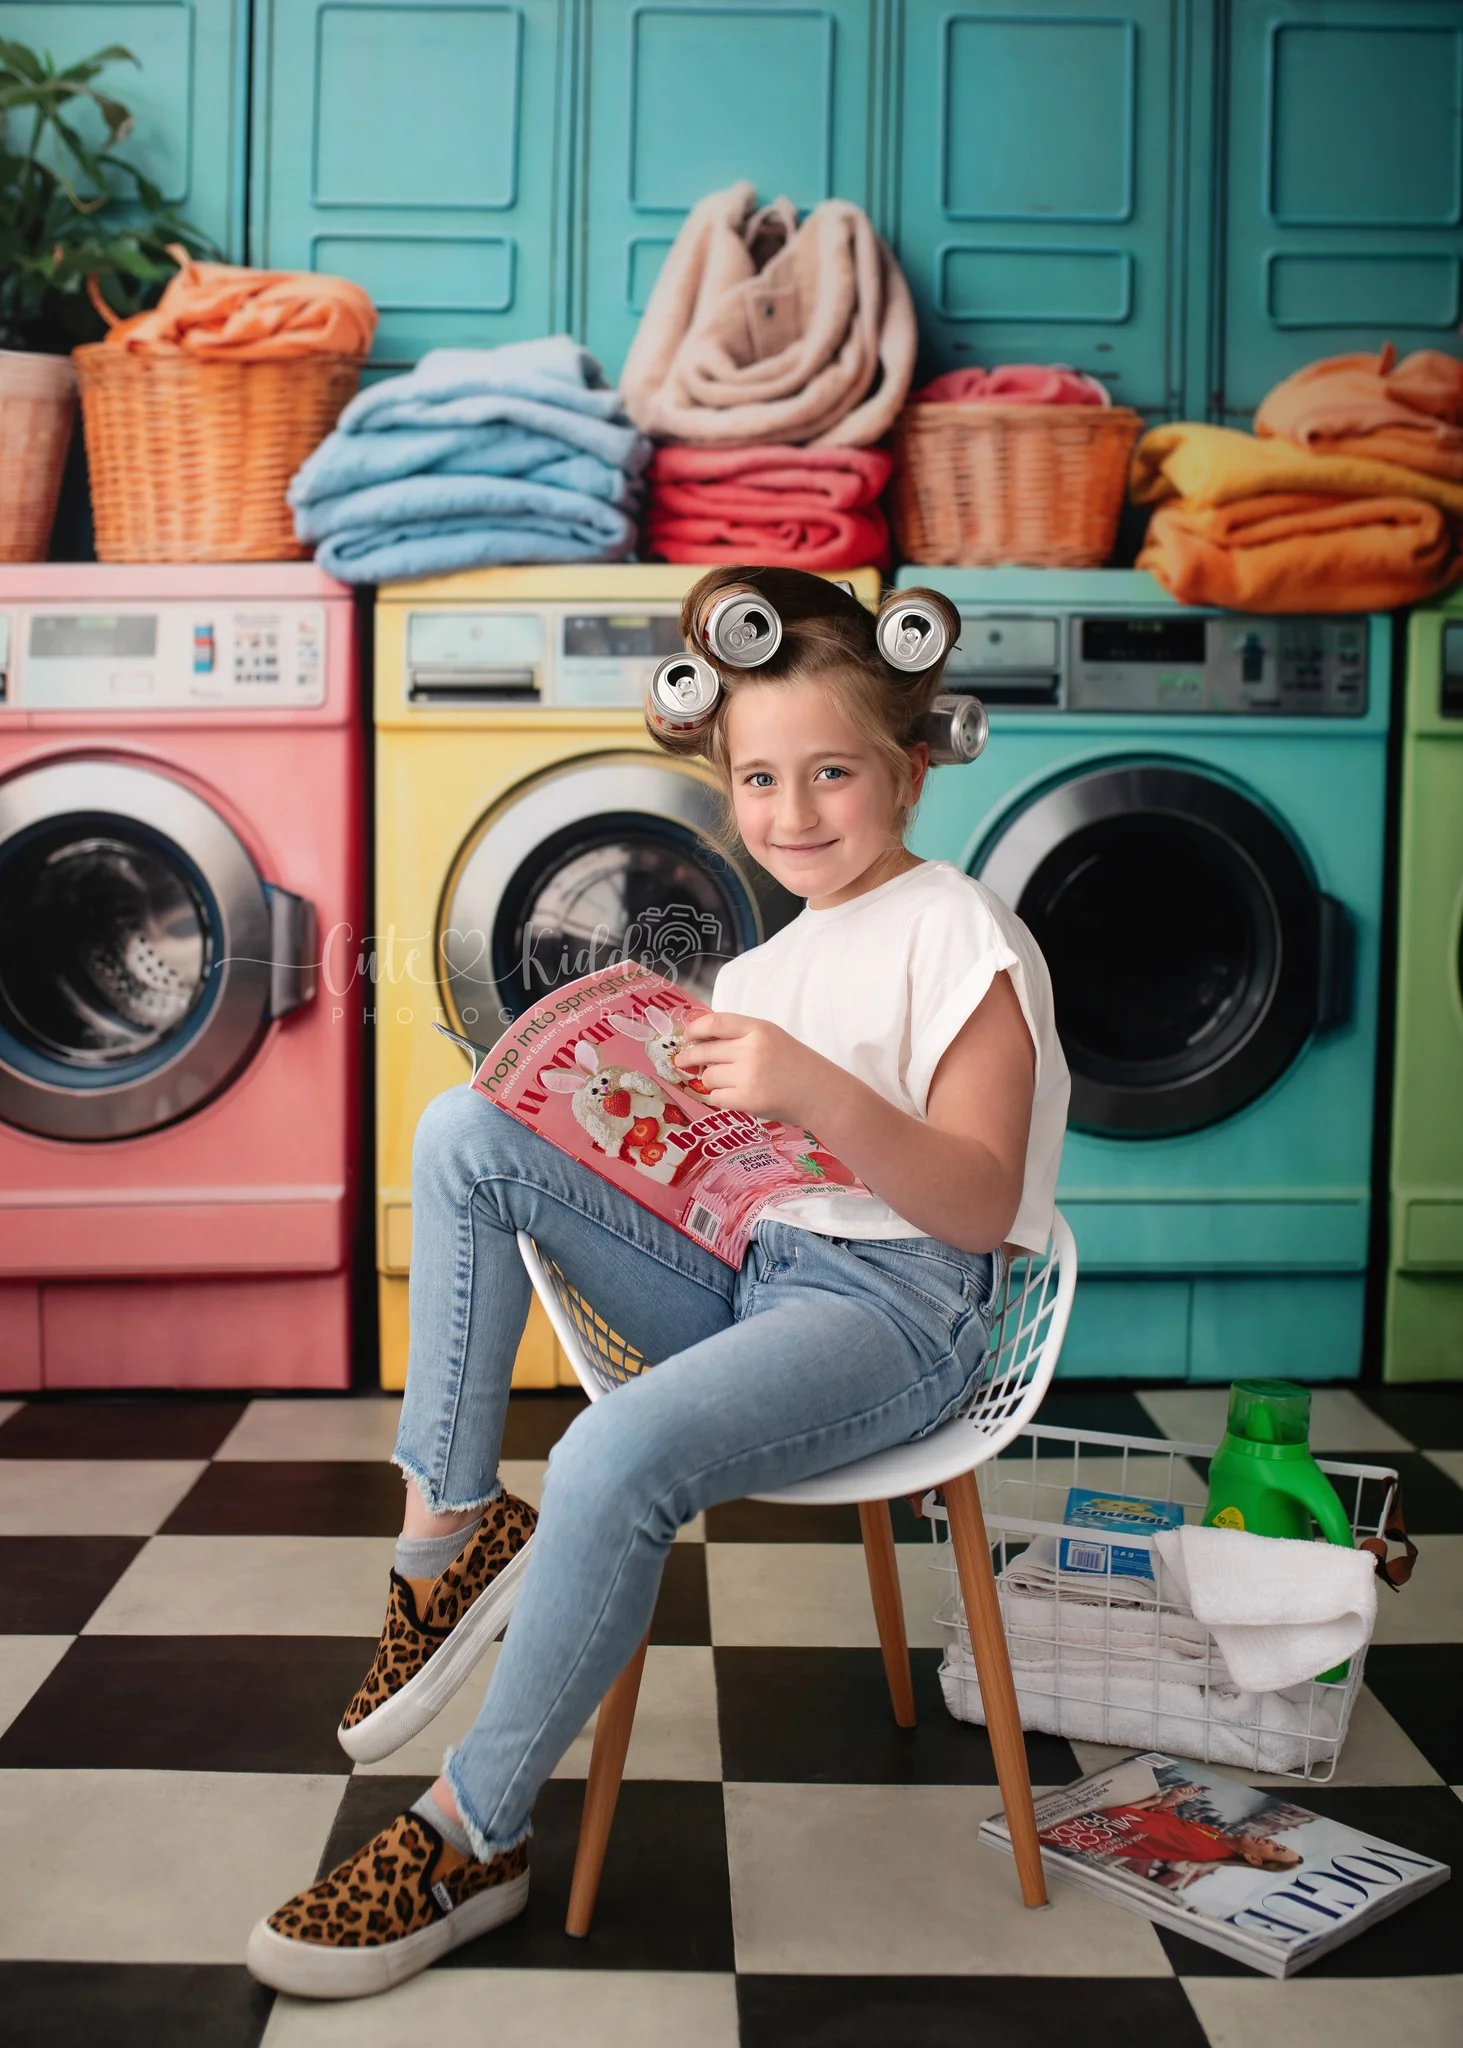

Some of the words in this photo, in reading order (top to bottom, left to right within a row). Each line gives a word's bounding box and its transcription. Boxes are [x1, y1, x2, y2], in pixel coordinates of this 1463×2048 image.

[480, 1048, 519, 1093] hop
[513, 1011, 556, 1047] into
[555, 968, 652, 1014] springtime
[500, 1055, 533, 1100] celebrate
[530, 1029, 562, 1055] Easter,
[596, 988, 631, 1007] Mother's
[630, 982, 648, 992] Day
[666, 1110, 757, 1151] berry
[740, 1152, 772, 1167] RECIPES
[751, 1158, 780, 1171] CRAFTS
[745, 1211, 758, 1229] NEW
[802, 1186, 825, 1194] better
[826, 1186, 847, 1194] sleep
[1039, 1812, 1109, 1841] PRADA
[1058, 1812, 1144, 1851] MIUCCIA
[1223, 1846, 1436, 1943] VOGUE
